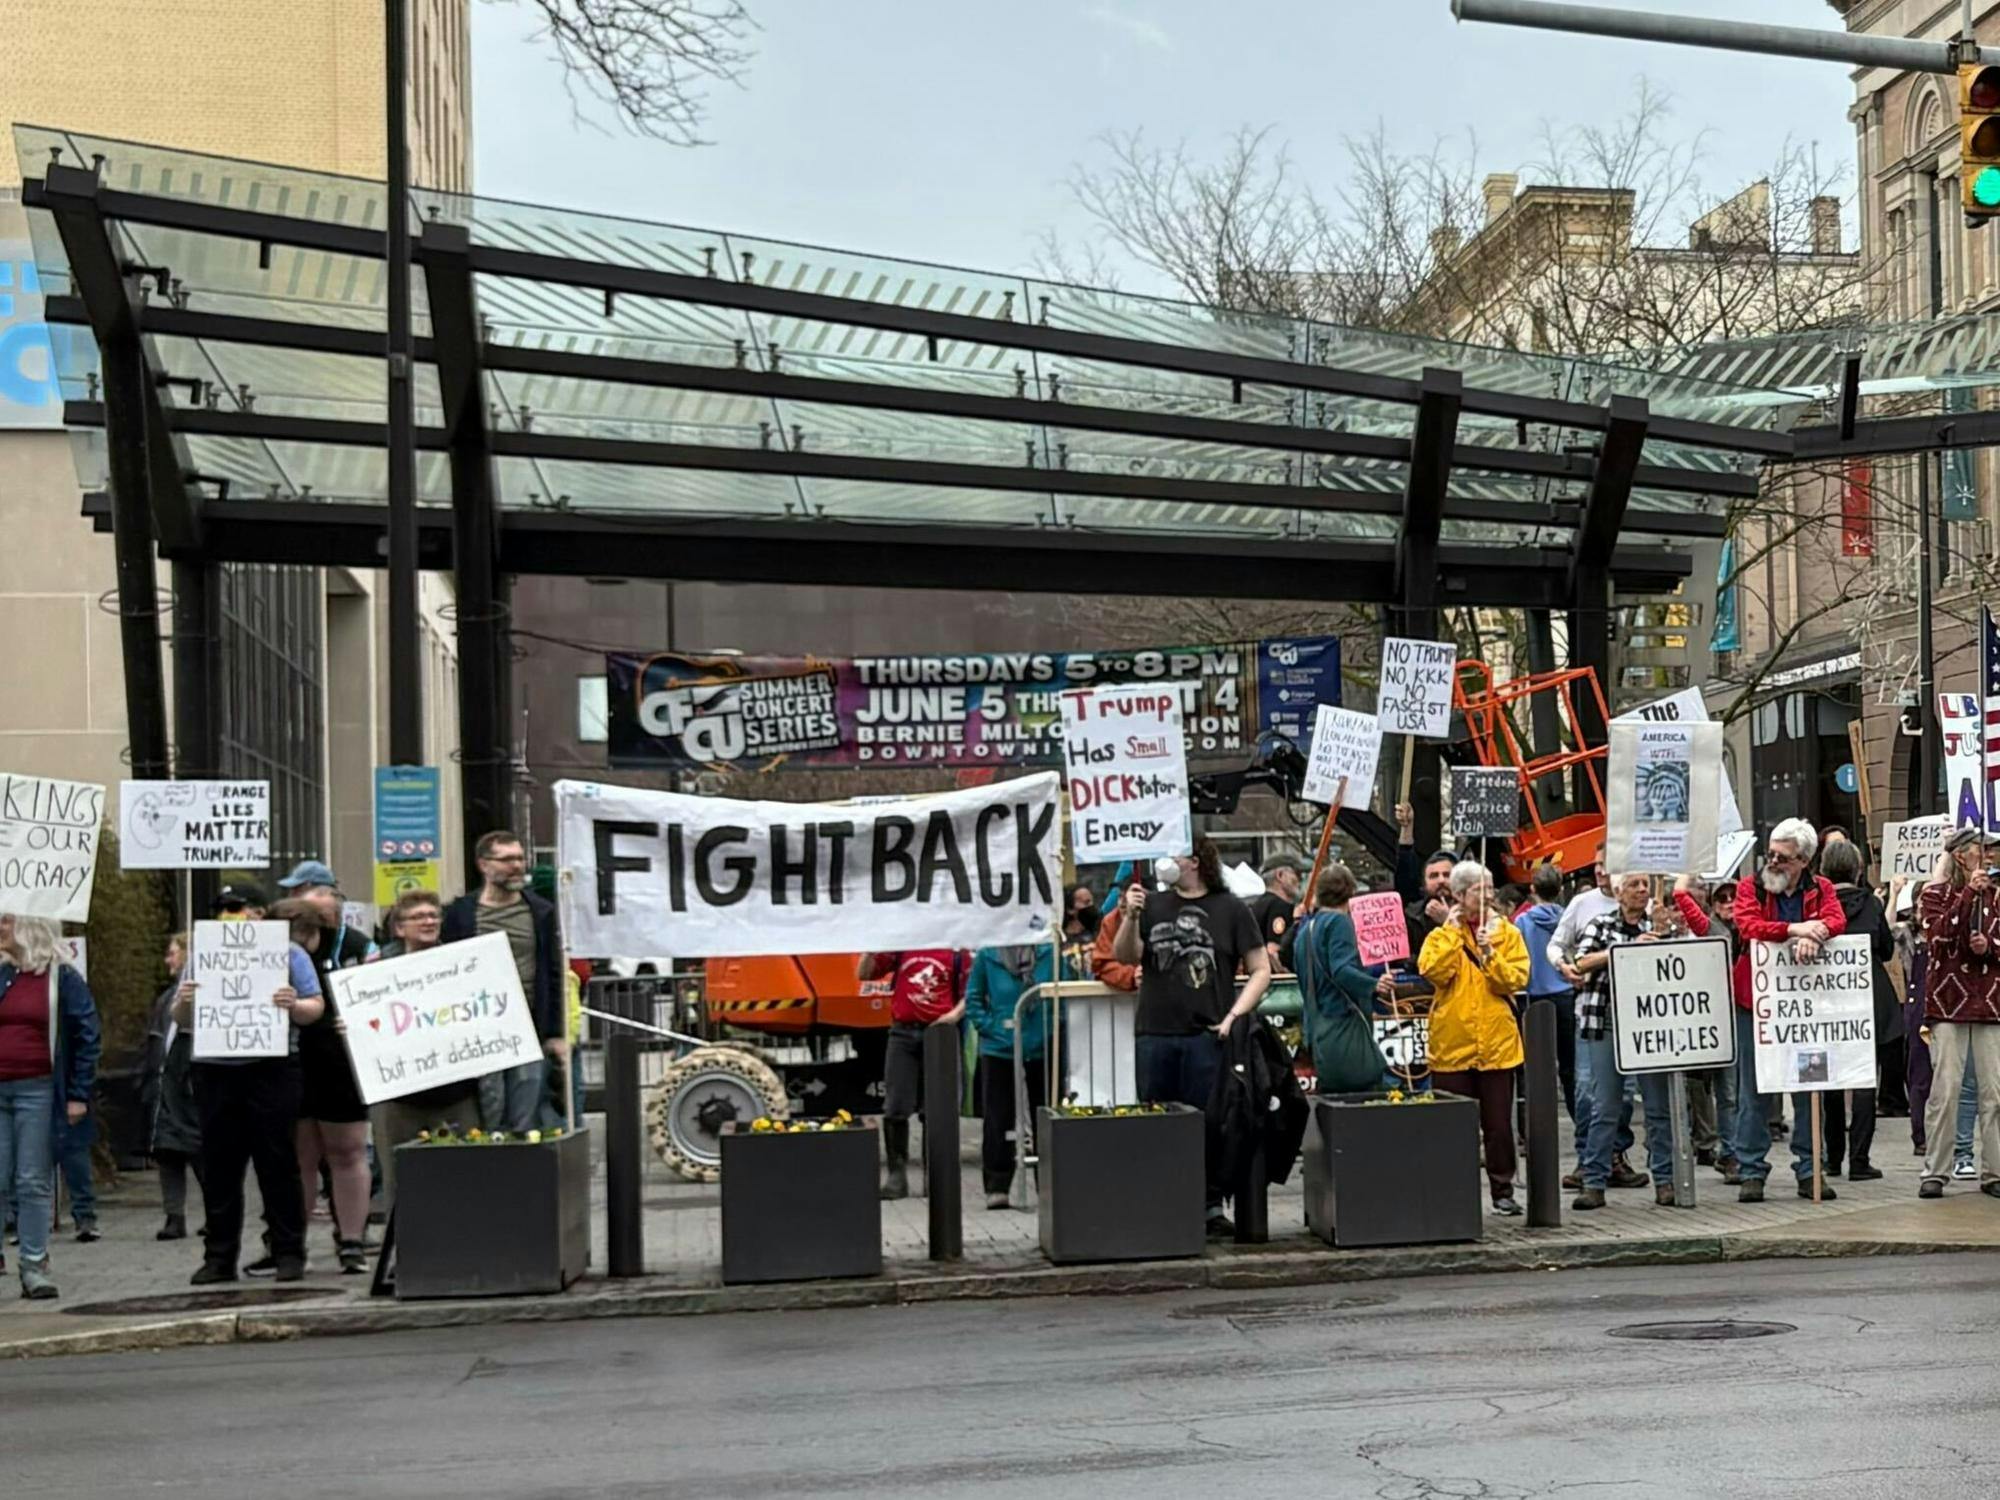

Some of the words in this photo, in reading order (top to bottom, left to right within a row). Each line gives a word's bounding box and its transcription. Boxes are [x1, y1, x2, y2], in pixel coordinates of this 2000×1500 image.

[1387, 642, 1410, 663] NO
[853, 654, 1053, 683] THURSDAYS
[1064, 652, 1097, 679] 5
[1102, 660, 1131, 673] TO
[1386, 666, 1406, 685] NO
[1413, 668, 1448, 685] KKK
[741, 674, 832, 700] SUMMER
[856, 688, 966, 722] JUNE
[980, 686, 1006, 720] 5
[1214, 677, 1239, 711] 4
[1405, 683, 1426, 701] NO
[742, 694, 833, 720] CONCERT
[1062, 691, 1173, 721] Trump
[1382, 697, 1446, 715] FASCIST
[746, 713, 837, 745] SERIES
[857, 725, 963, 742] BERNIE
[981, 723, 1064, 740] MILTO
[1397, 713, 1427, 730] USA
[1641, 732, 1686, 742] AMERICA
[859, 742, 1062, 759] DOWNTOWNI
[1068, 738, 1115, 766] Has
[1125, 736, 1170, 758] Small
[4, 775, 103, 827] KINGS
[1070, 773, 1177, 811] DICKtator
[212, 803, 254, 818] LIES
[1456, 799, 1511, 814] Justice
[27, 826, 91, 854] OUR
[185, 820, 269, 842] MATTER
[1085, 818, 1164, 846] Energy
[1898, 825, 1942, 841] RESIS
[182, 846, 233, 863] TRUMP
[592, 818, 855, 916] FIGHT
[870, 802, 1056, 908] BACK
[0, 857, 91, 904] OCRACY
[223, 922, 257, 948] NO
[1656, 957, 1686, 981] NO
[222, 973, 251, 1000] NO
[390, 988, 508, 1036] Diversity
[1636, 991, 1711, 1018] MOTOR
[377, 1056, 405, 1084] but
[415, 1049, 439, 1073] not
